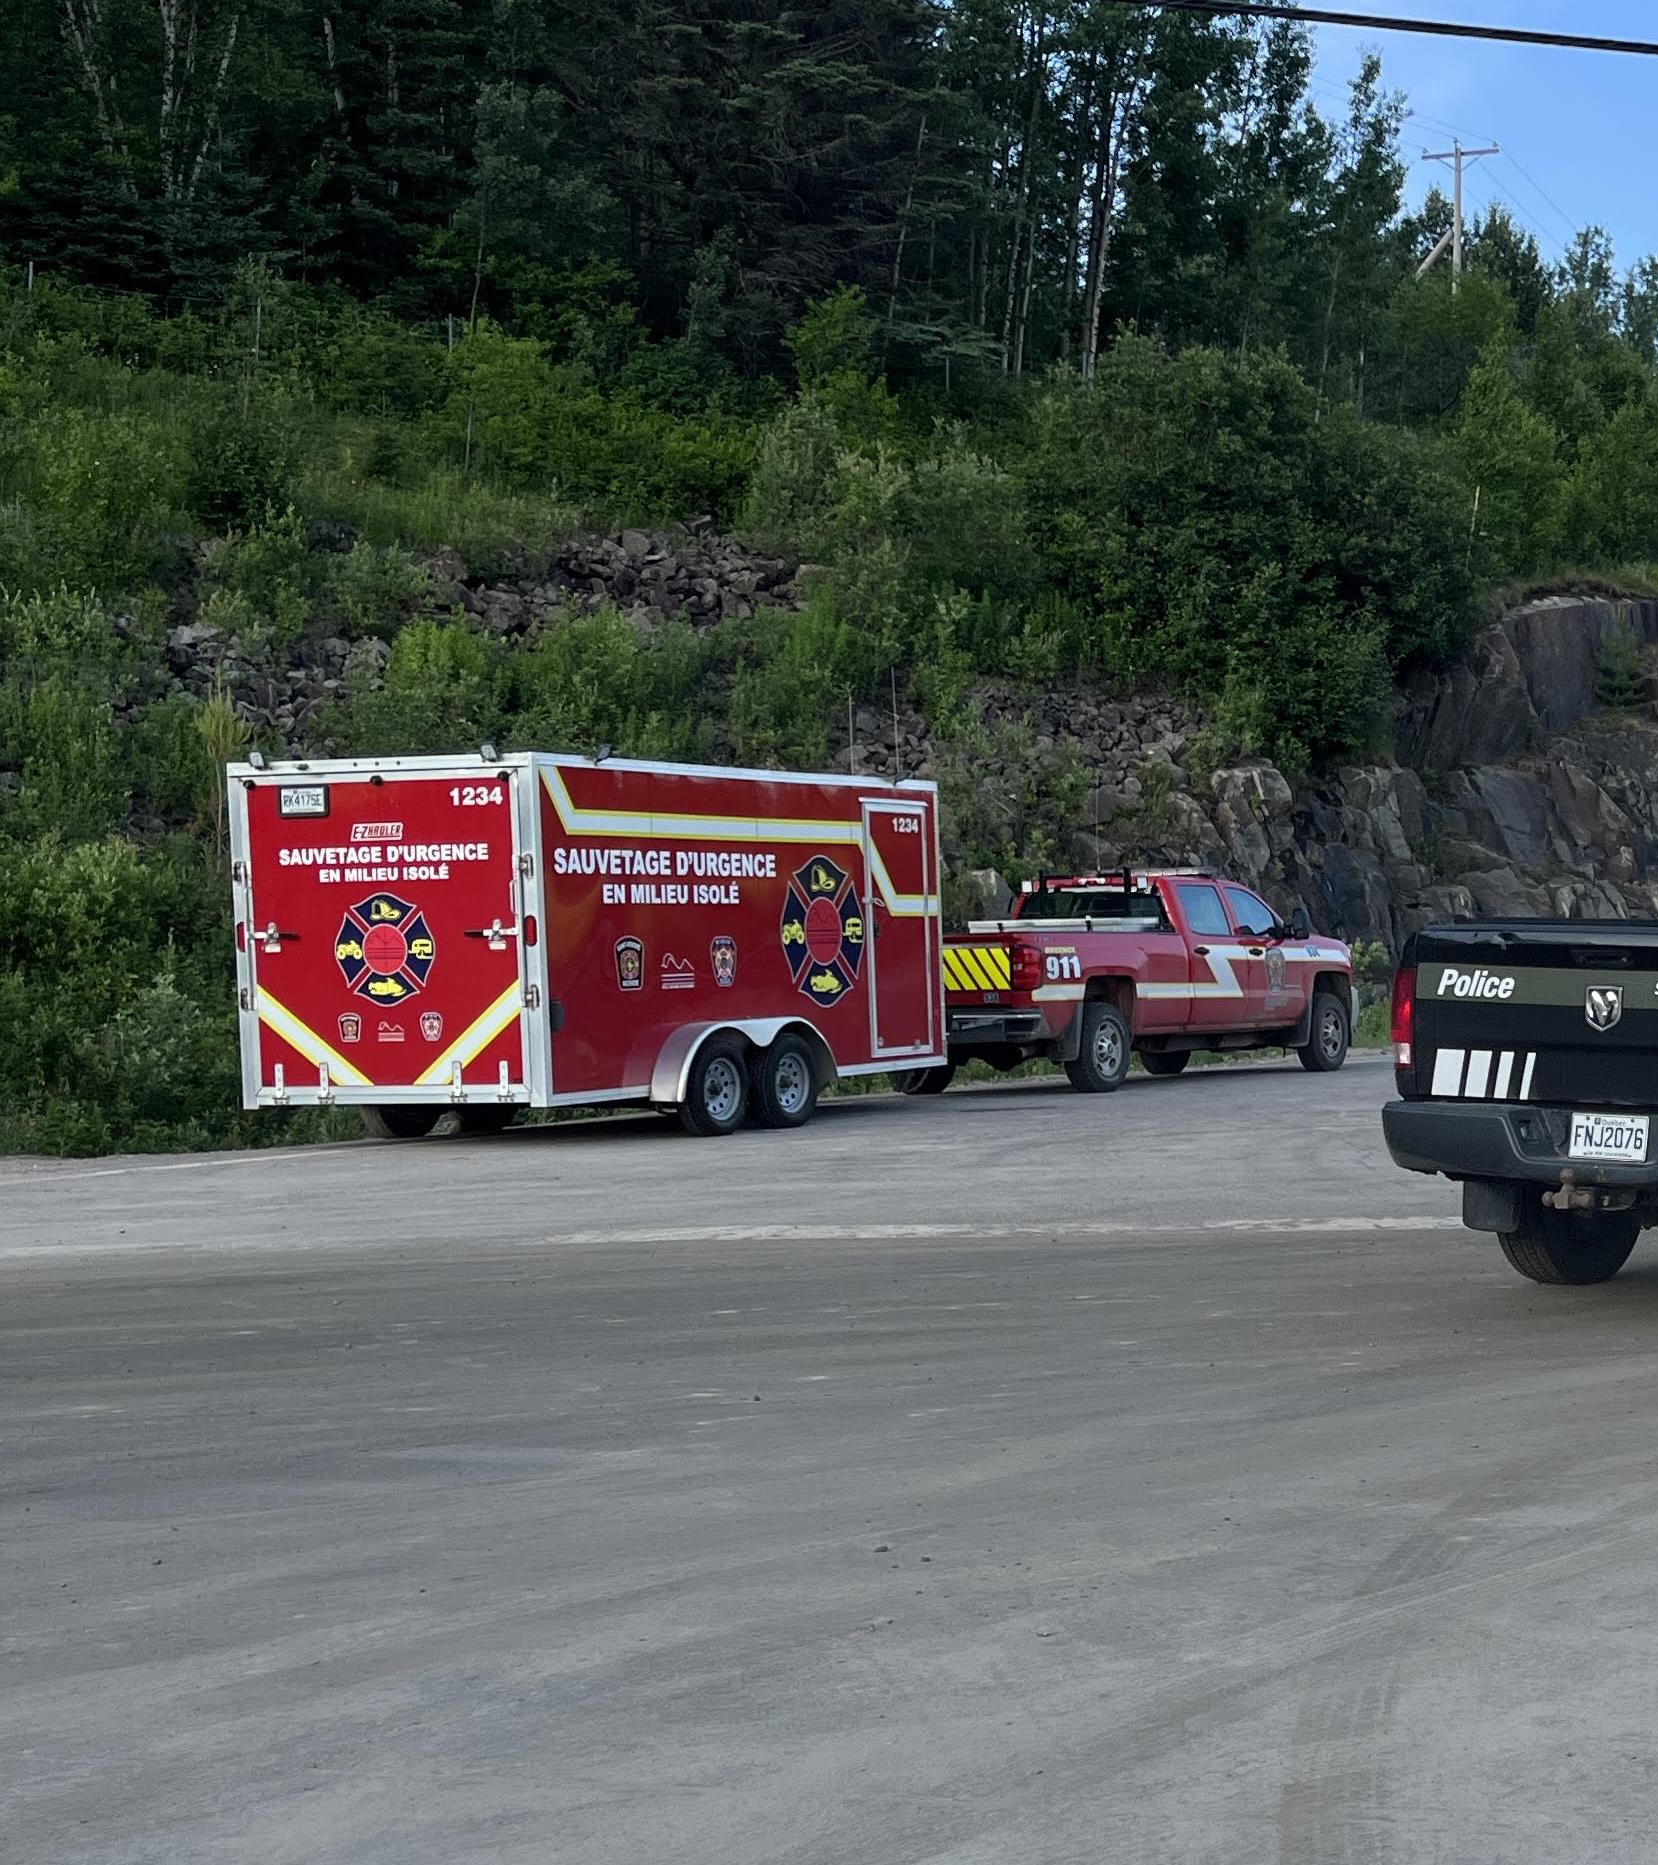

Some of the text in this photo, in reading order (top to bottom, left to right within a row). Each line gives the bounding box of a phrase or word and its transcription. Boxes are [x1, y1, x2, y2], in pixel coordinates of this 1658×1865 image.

[449, 787, 503, 806] 1234
[892, 817, 919, 834] 1234
[279, 843, 489, 866] SAUVETAGE D'URGENCE
[554, 847, 777, 878] SAUVETAGE D'URGENCE
[319, 863, 450, 883] EN MILIEU ISOLÉ
[602, 881, 740, 905] EN MILIEU ISOLÉ
[1046, 955, 1081, 980] 911
[1437, 968, 1515, 1000] Police
[1574, 1125, 1644, 1150] FNJ2076
